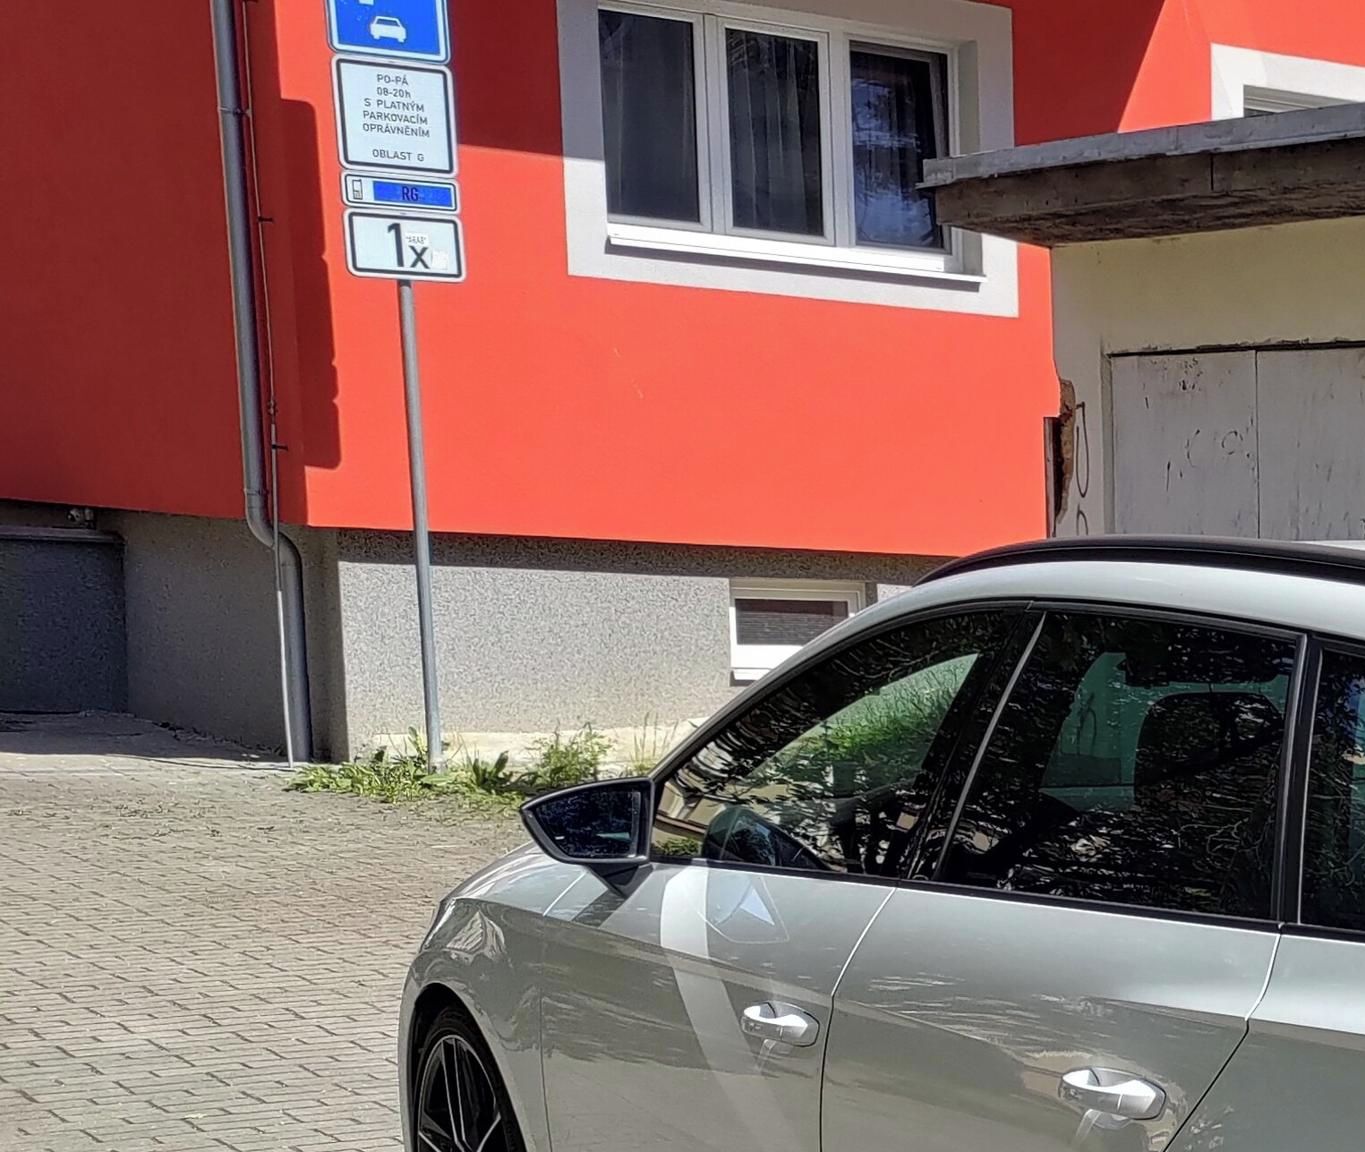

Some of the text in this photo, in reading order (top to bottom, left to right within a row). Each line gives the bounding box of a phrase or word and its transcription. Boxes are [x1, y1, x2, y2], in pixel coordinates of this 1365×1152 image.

[376, 73, 409, 86] PO-PÁ
[376, 86, 411, 99] 08-20h
[363, 97, 425, 113] S PLATNÝM
[362, 110, 428, 125] PARKOVACÍM
[362, 122, 430, 138] OPRÁVNĚNÍM
[372, 148, 424, 162] OBLAST G
[401, 186, 419, 202] RG
